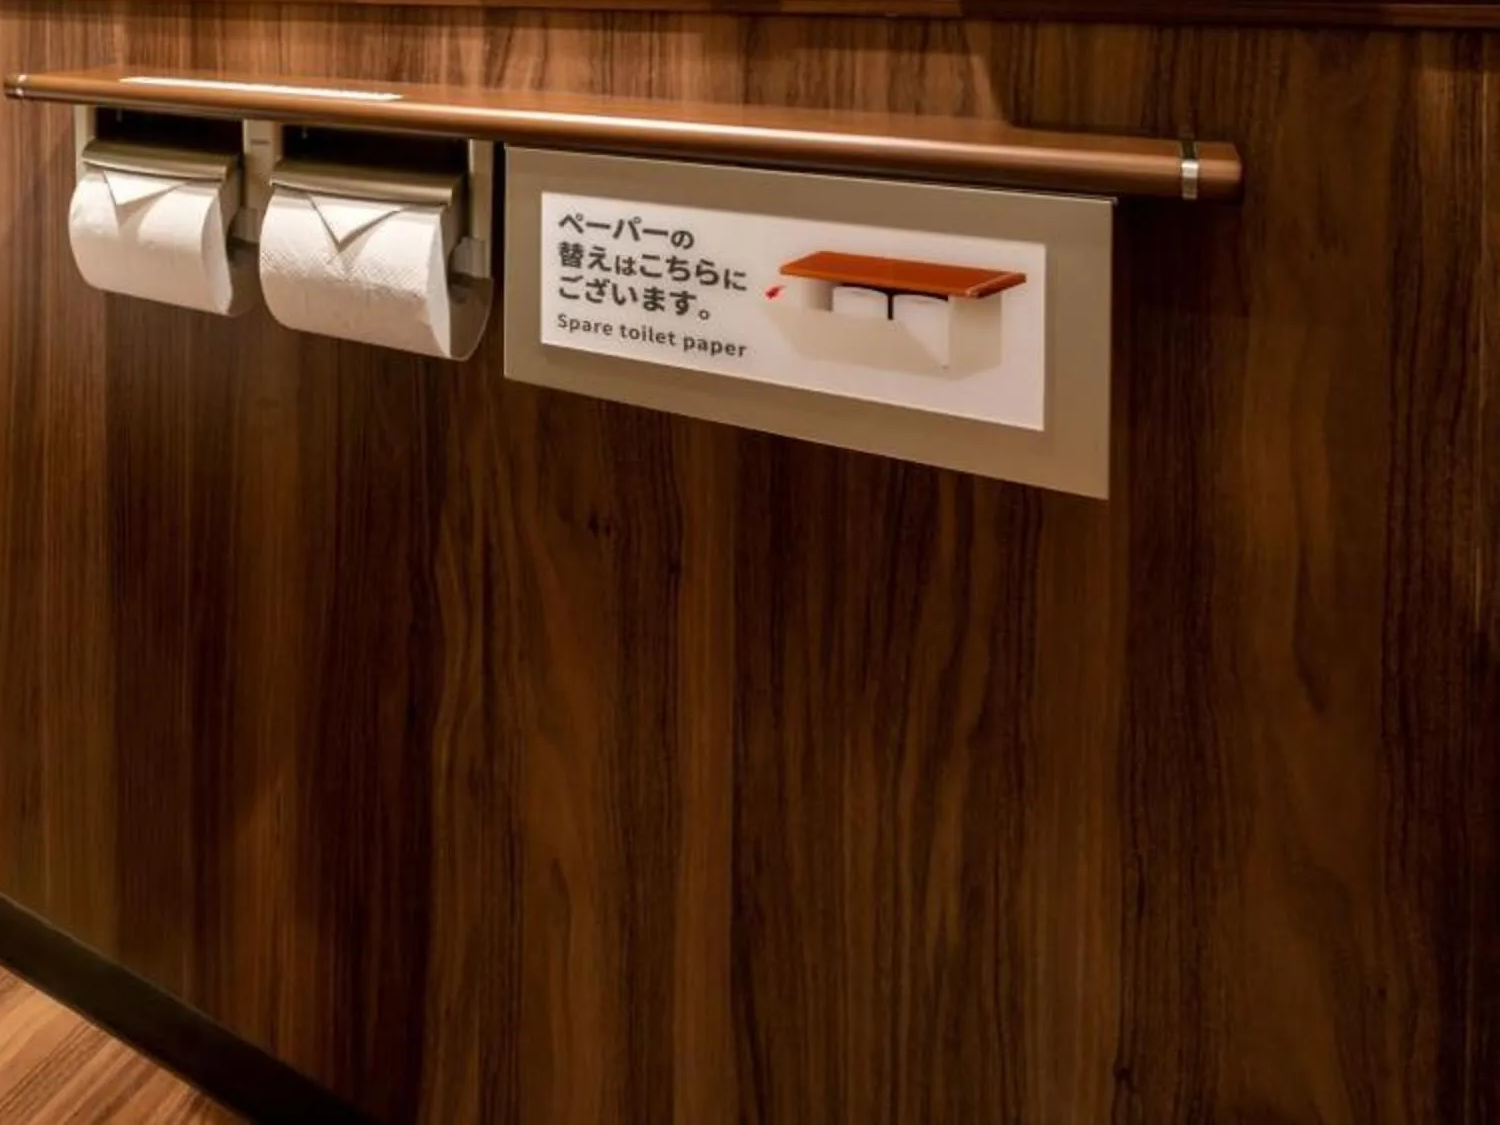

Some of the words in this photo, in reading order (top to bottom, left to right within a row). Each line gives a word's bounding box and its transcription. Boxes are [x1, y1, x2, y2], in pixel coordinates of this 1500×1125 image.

[558, 212, 695, 250] ペーパーの
[558, 241, 748, 292] 替えはこちらに
[558, 275, 711, 321] ございます。
[557, 313, 614, 336] Spare
[619, 324, 677, 346] toilet
[683, 334, 748, 358] paper
